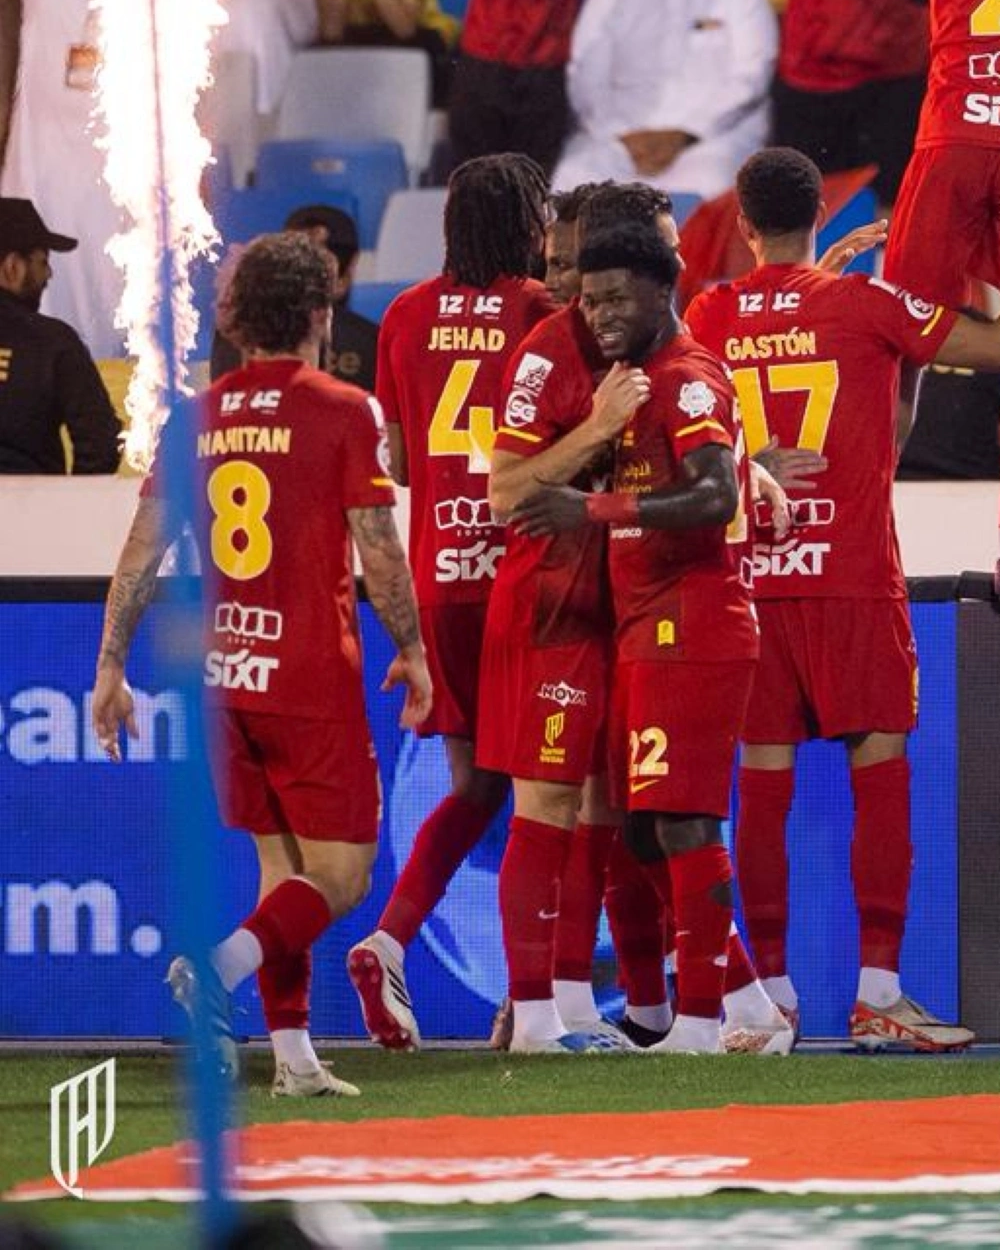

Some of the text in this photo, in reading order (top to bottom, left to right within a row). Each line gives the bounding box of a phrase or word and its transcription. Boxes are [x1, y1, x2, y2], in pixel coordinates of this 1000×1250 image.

[428, 326, 505, 352] JEHAD
[725, 326, 816, 361] GASTÓN
[427, 359, 497, 474] 4
[733, 360, 839, 460] 17
[207, 460, 273, 580] 8
